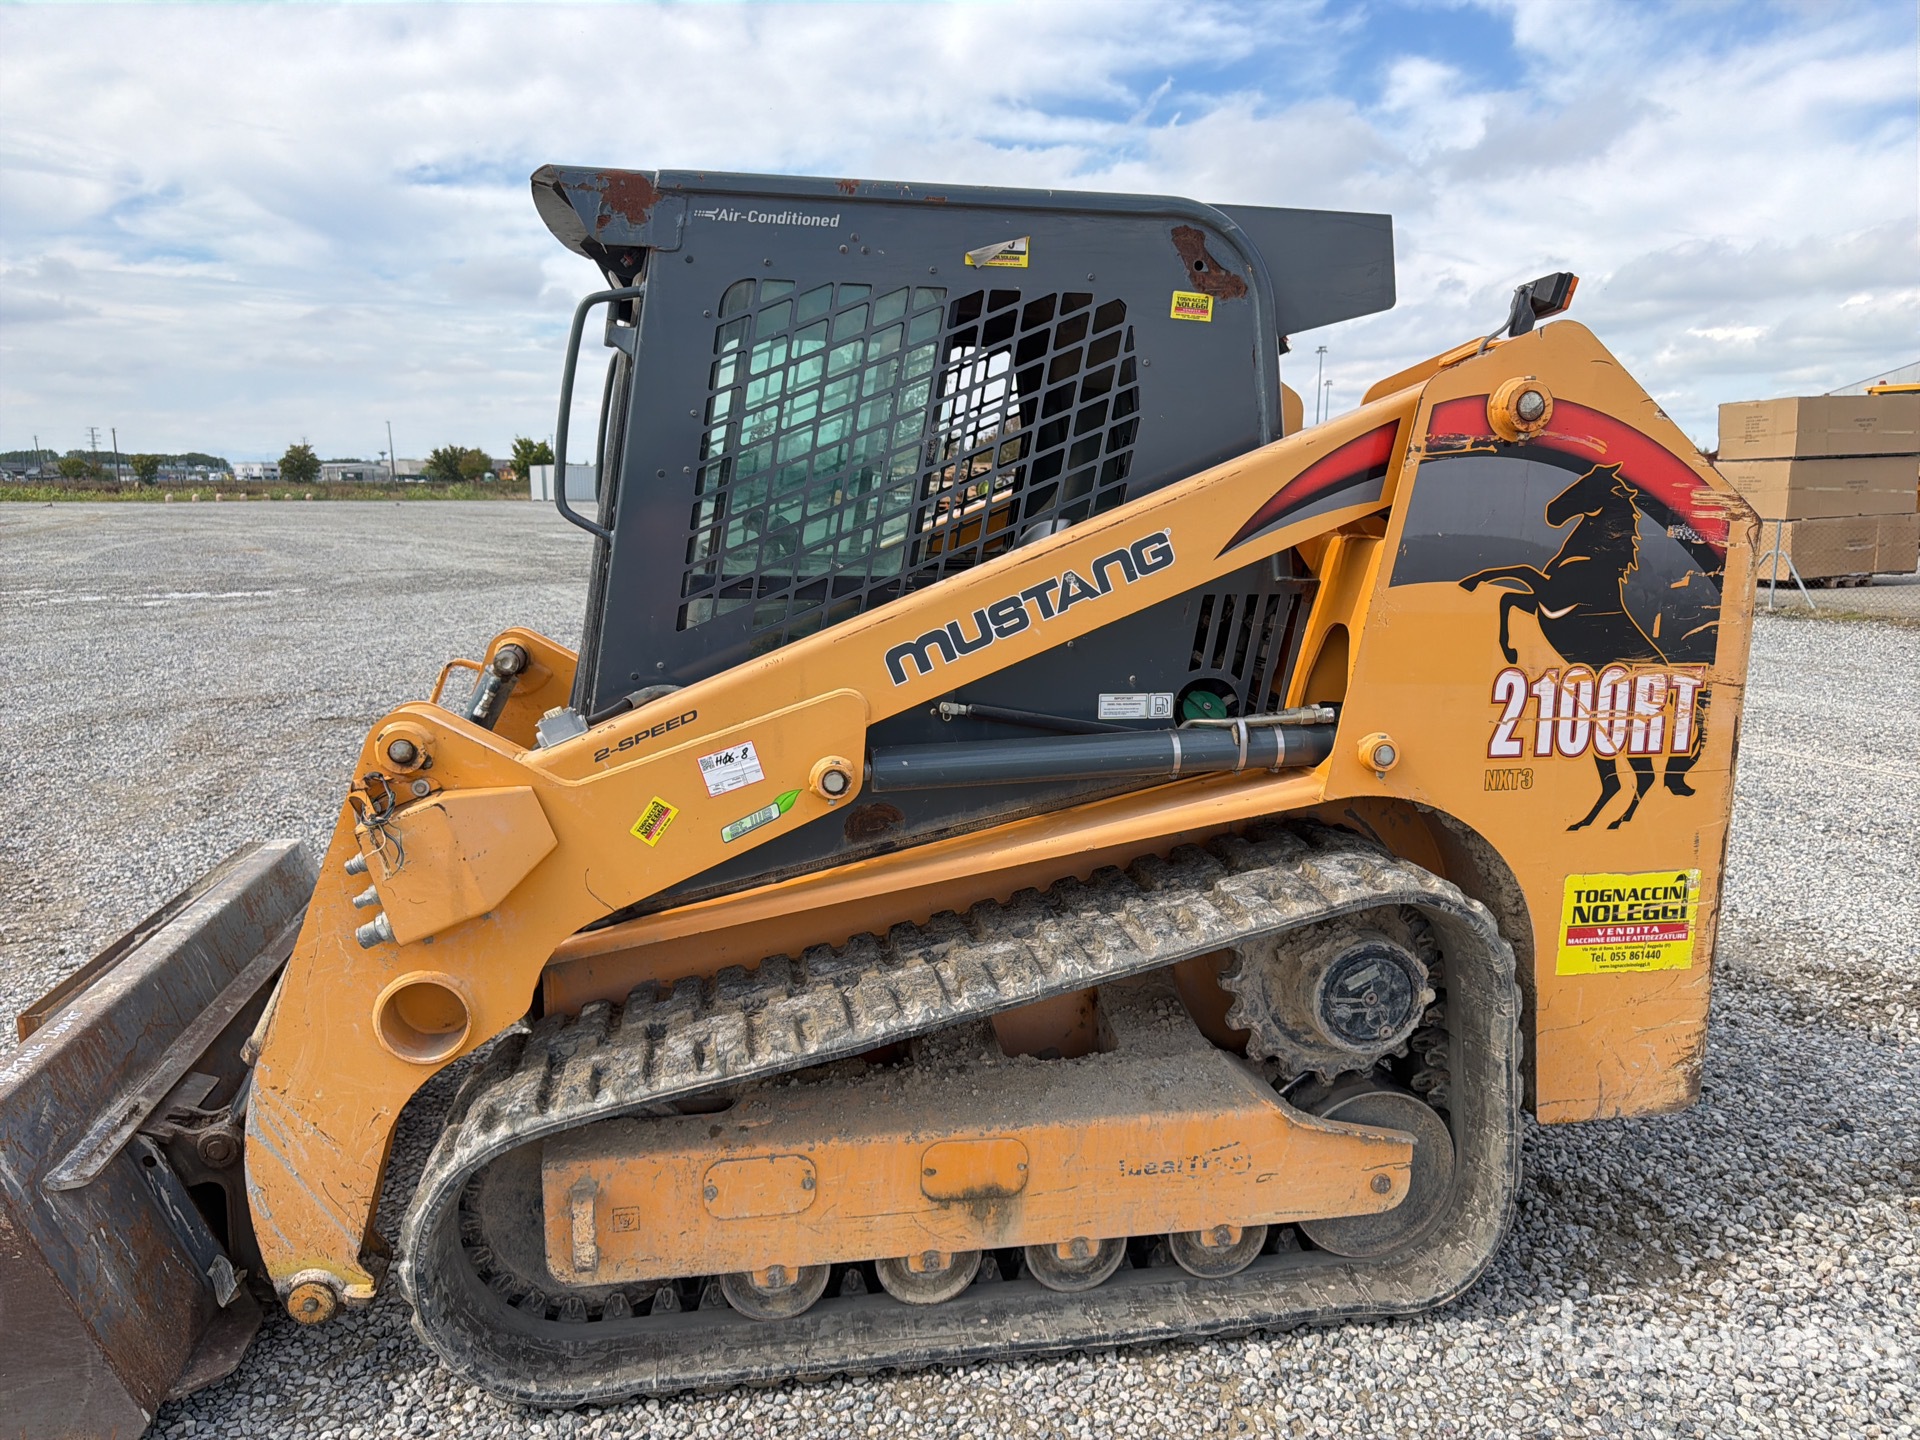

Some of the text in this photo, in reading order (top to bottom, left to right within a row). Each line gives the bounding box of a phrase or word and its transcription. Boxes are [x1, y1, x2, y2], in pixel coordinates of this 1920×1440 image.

[717, 208, 841, 228] Air-Conditioned
[884, 530, 1176, 686] MUSTANG
[1487, 665, 1704, 758] 2100RT
[593, 709, 698, 763] 2-SPEED
[1484, 768, 1534, 791] NXT3
[1574, 885, 1687, 904] TOGNACCINI
[1571, 902, 1688, 924] NOLEGGI
[1567, 936, 1605, 945] MACCHINE
[1606, 935, 1626, 943] EDILI
[1597, 925, 1660, 936] VENDITA
[1591, 950, 1661, 962] Tel. 055 861440
